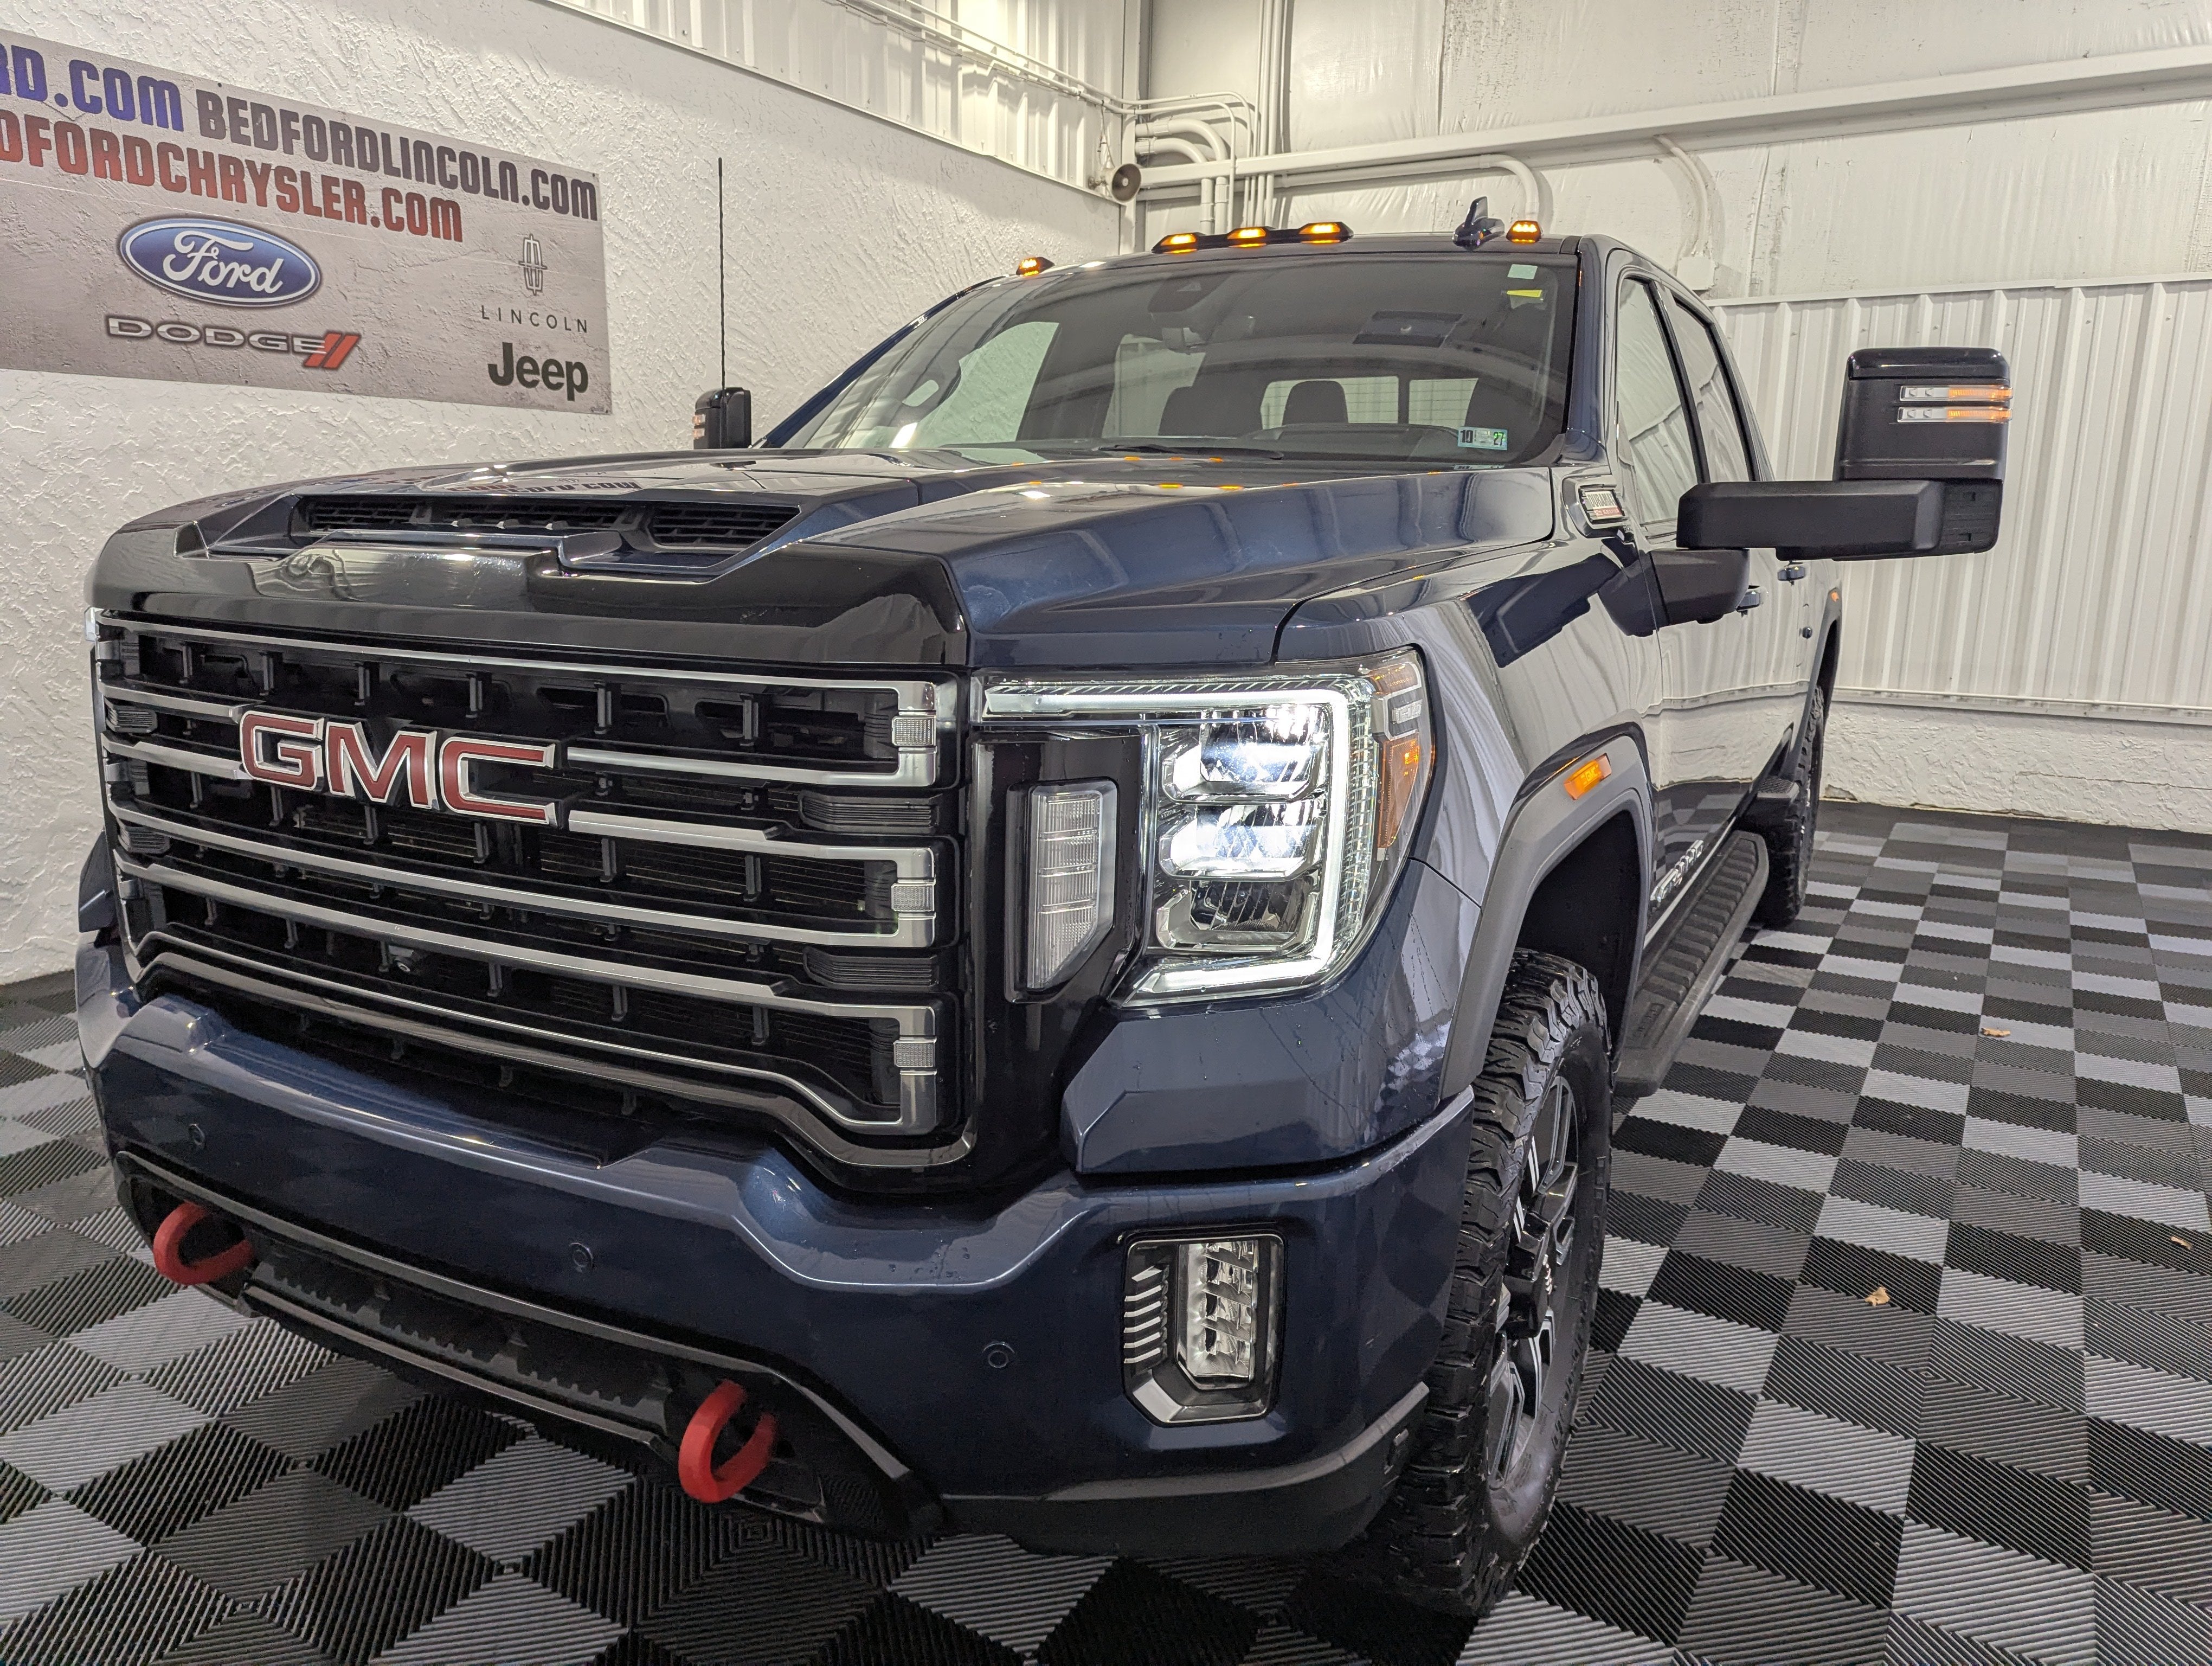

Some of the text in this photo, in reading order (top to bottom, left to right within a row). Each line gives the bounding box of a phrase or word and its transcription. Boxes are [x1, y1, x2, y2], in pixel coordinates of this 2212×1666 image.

[196, 89, 597, 221] BEDFORDLINCOLN.COM
[163, 230, 285, 293] Ford
[108, 317, 327, 354] DODGE
[481, 305, 587, 333] LINCOLN
[488, 342, 588, 401] Jeep
[1494, 432, 1504, 446] 27
[240, 710, 556, 825] GMC
